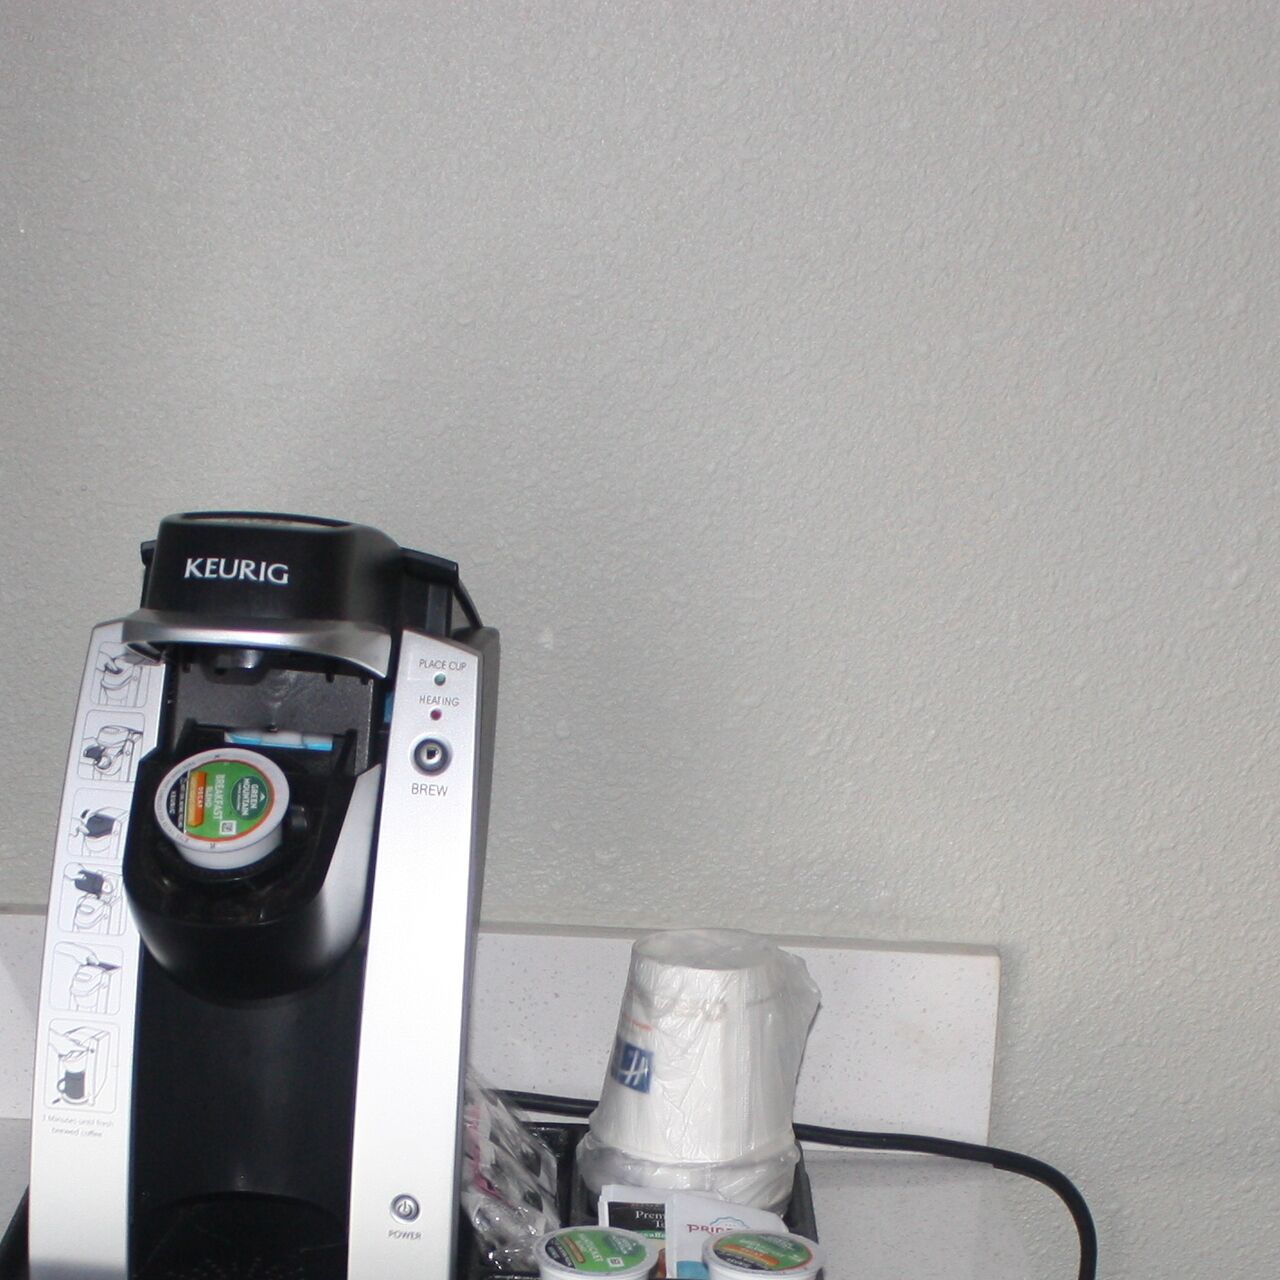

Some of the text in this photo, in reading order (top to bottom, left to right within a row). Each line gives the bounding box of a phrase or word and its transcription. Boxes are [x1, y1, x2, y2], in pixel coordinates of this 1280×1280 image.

[184, 558, 289, 584] KEURIG
[419, 658, 467, 671] PLACE CUP
[419, 695, 460, 707] HEATING
[213, 773, 226, 821] BREAKFAST
[241, 777, 251, 816] MOUNTAIN
[250, 783, 259, 810] GREEN
[411, 783, 448, 797] BREW
[388, 1229, 422, 1240] POWER
